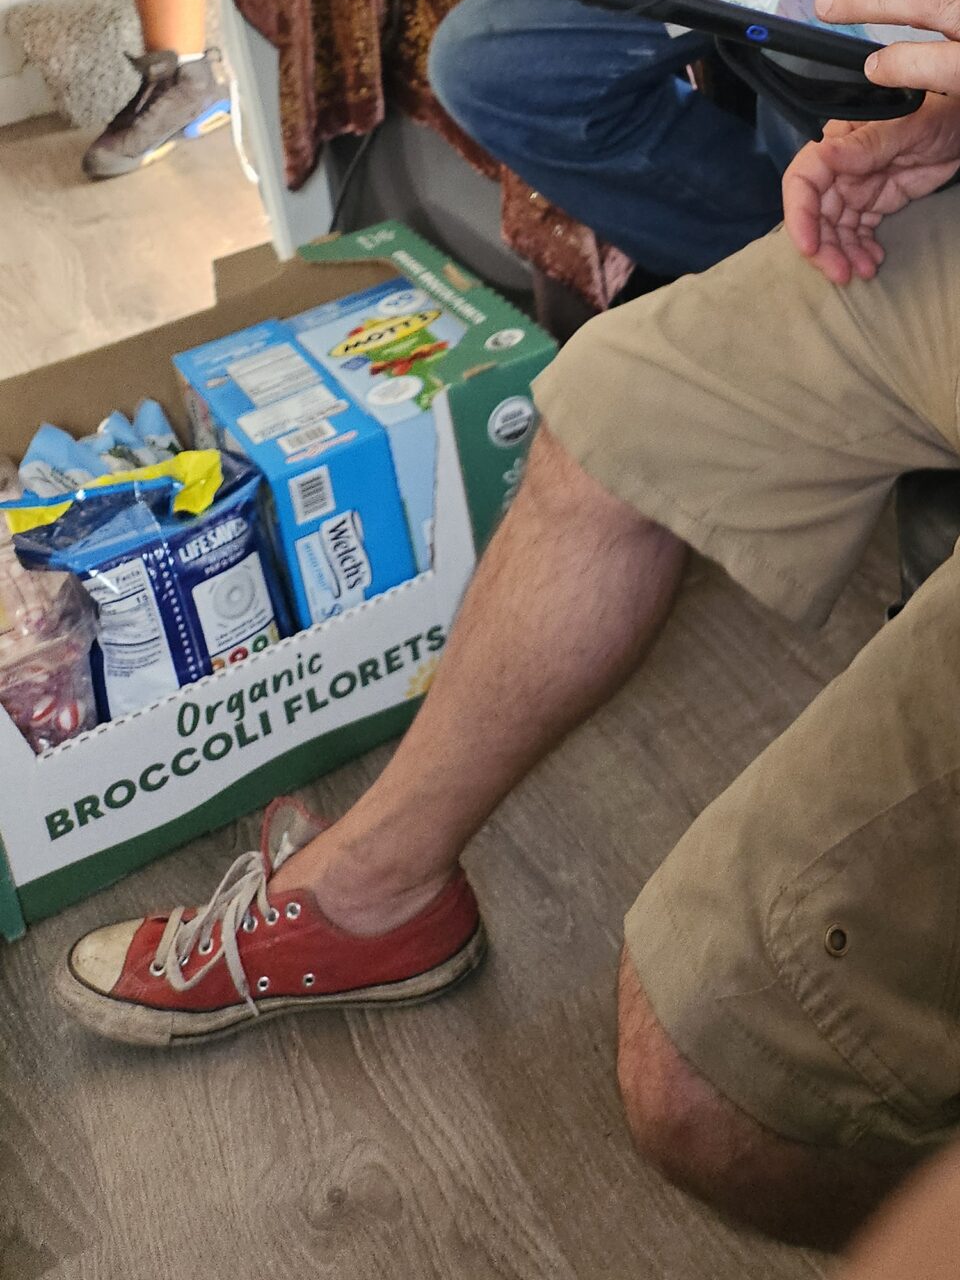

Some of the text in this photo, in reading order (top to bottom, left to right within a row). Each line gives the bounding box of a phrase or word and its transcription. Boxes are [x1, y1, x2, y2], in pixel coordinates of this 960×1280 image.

[328, 518, 366, 591] Welch's
[44, 710, 272, 842] BROCCOLI
[285, 625, 447, 724] FLORETS
[177, 650, 324, 737] Organic
